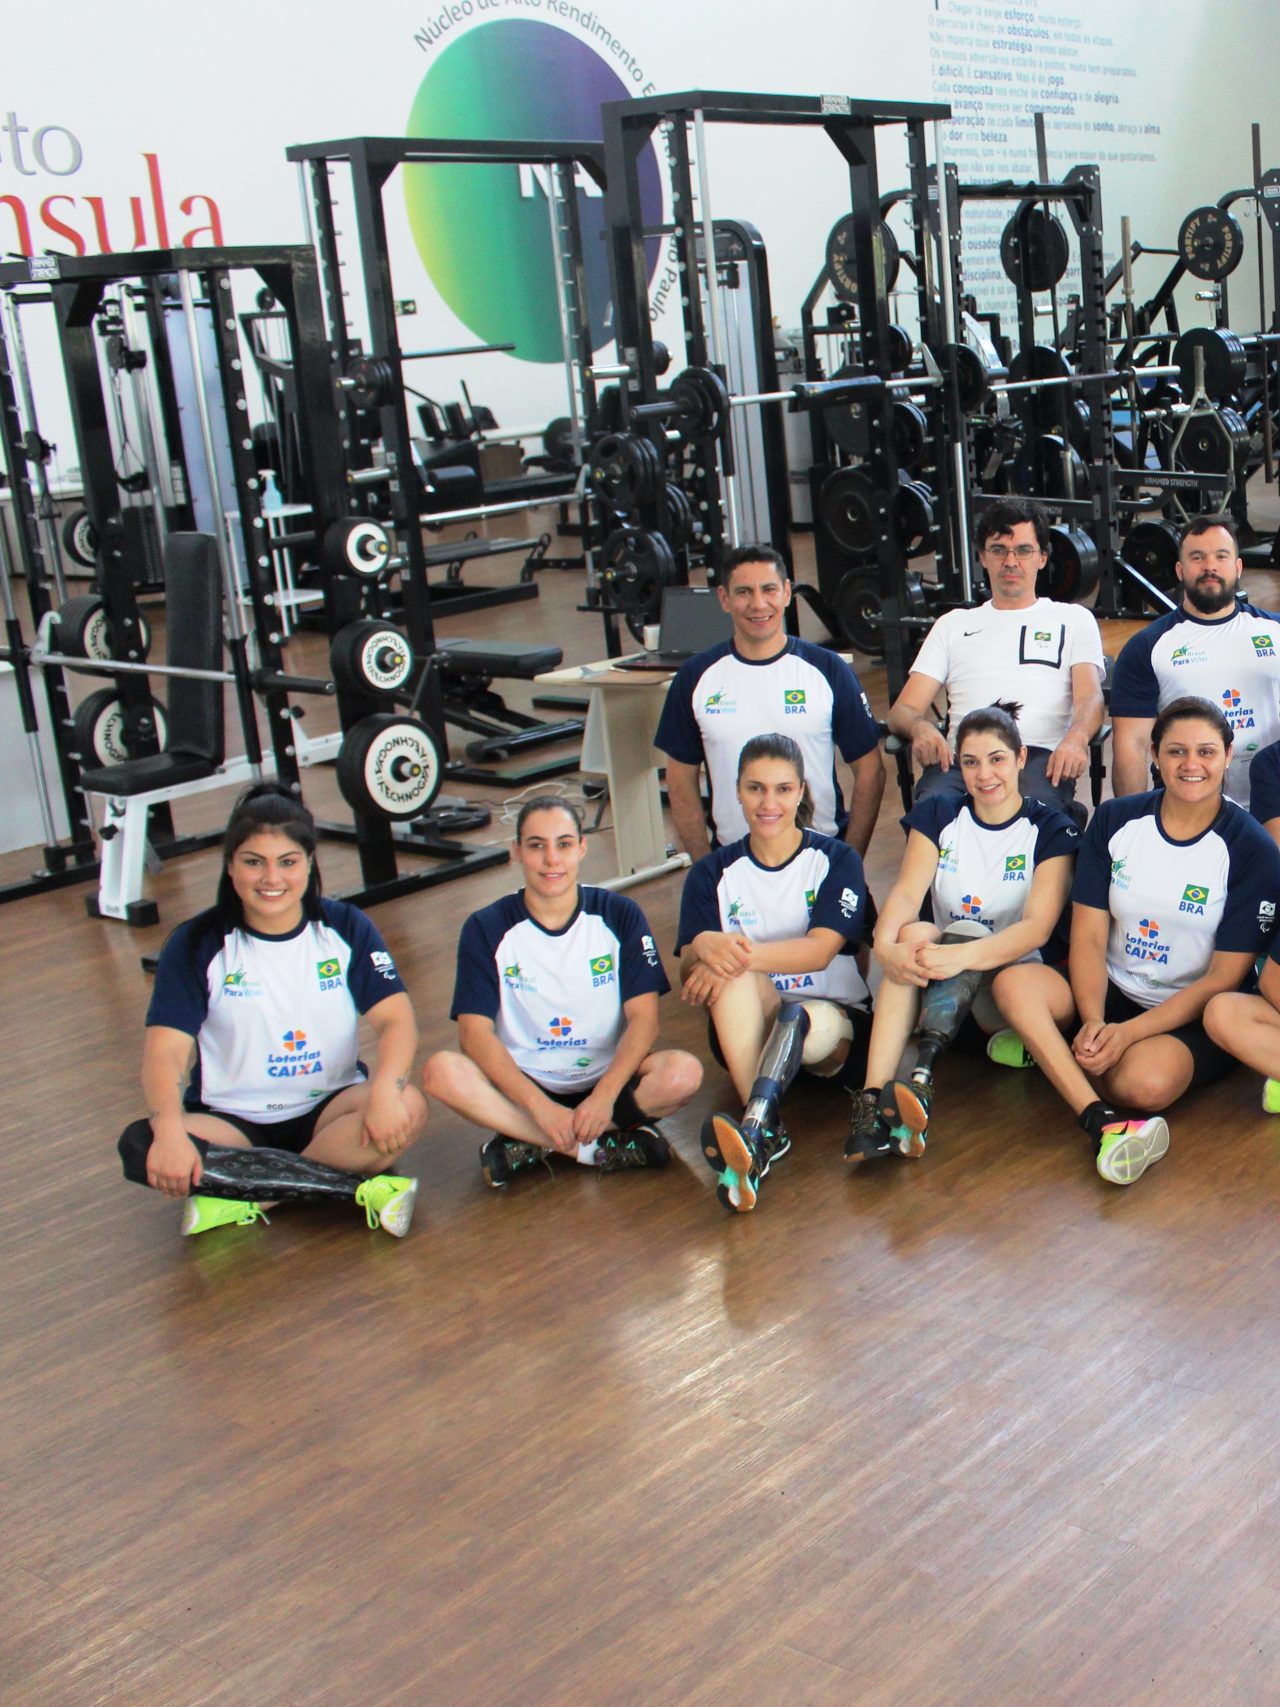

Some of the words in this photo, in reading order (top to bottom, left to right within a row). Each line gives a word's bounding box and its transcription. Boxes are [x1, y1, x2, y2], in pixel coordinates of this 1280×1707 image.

[413, 1, 474, 53] Núcleo
[547, 0, 644, 83] Rendimento
[992, 39, 1033, 55] estratégia
[953, 84, 993, 98] conquista
[1216, 225, 1234, 270] FORTIFY
[648, 271, 678, 322] Paulo
[1256, 648, 1276, 658] BRA
[1173, 658, 1190, 668] Para
[785, 705, 806, 714] BRA
[1224, 707, 1254, 718] terias
[1230, 717, 1255, 730] IXA
[375, 736, 428, 777] TECHNOGYM
[378, 763, 429, 803] TECHNOGYM
[1003, 871, 1025, 882] BRA
[1178, 901, 1205, 916] BRA
[1125, 933, 1171, 952] Loterias
[1125, 944, 1169, 966] CAIXA
[319, 977, 342, 992] BRA
[593, 973, 616, 988] BRA
[775, 975, 814, 991] AIXA
[223, 987, 243, 998] Para
[537, 1037, 587, 1048] Loterias
[268, 1050, 321, 1064] Loterias
[267, 1061, 323, 1078] CAIXA
